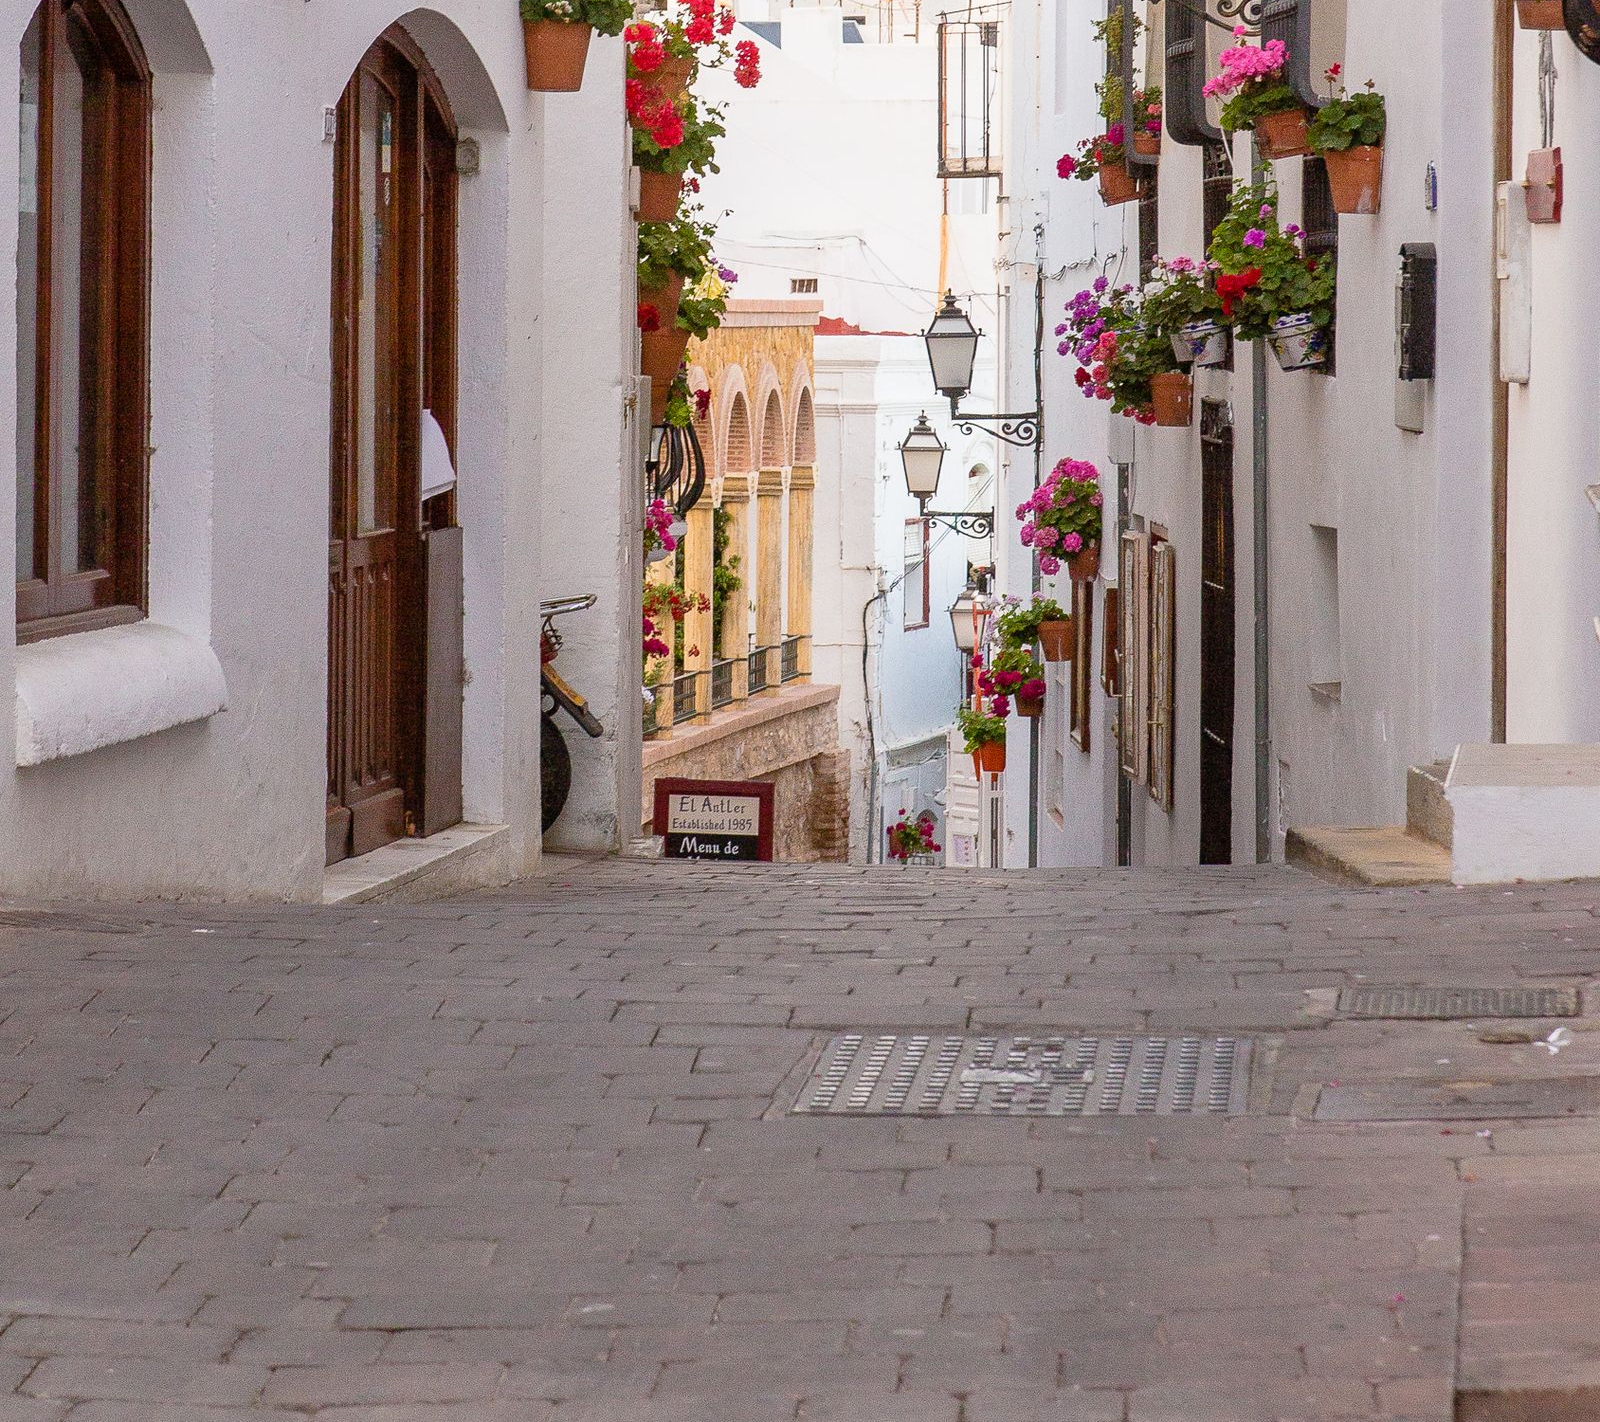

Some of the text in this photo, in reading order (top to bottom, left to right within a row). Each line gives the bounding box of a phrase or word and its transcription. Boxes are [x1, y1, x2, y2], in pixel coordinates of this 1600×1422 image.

[679, 796, 746, 814] El Antler
[672, 818, 752, 831] Established 1985
[679, 836, 740, 854] Menu de
